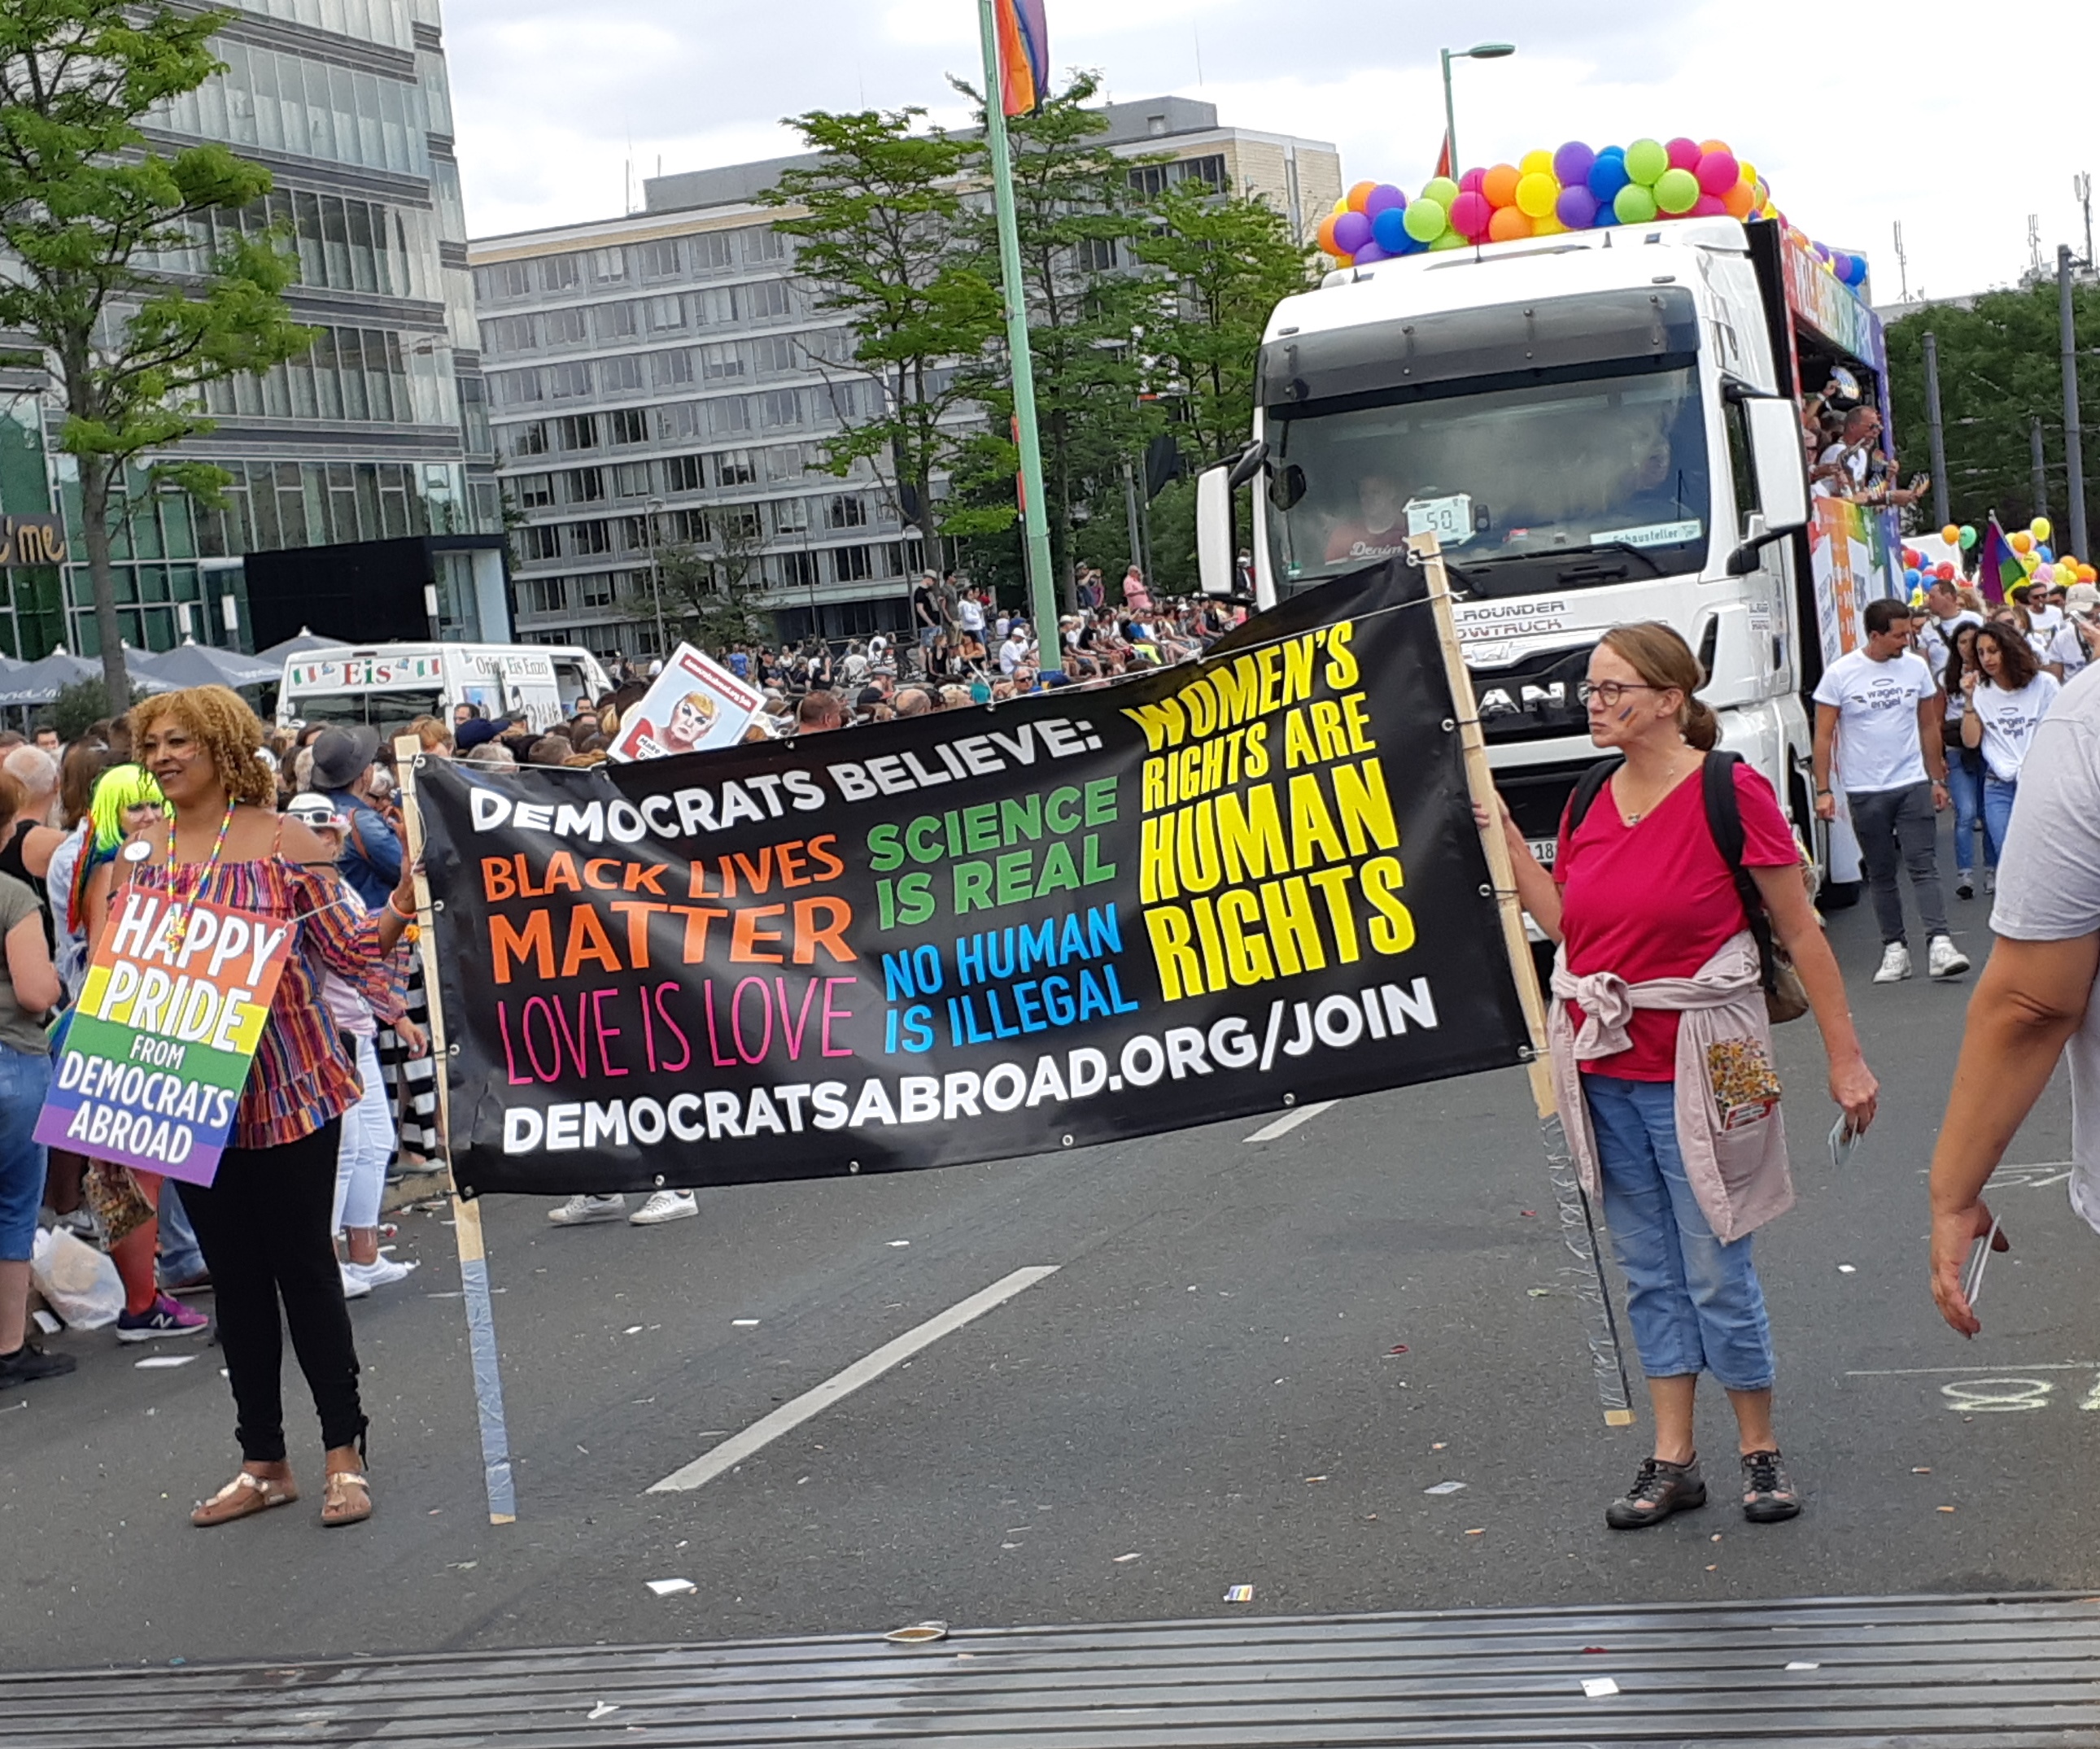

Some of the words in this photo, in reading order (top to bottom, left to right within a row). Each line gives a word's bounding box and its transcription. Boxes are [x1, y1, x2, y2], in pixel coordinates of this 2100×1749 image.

[1426, 510, 1452, 531] 50
[343, 659, 392, 686] Eis
[1120, 620, 1360, 753] WOMEN'S
[1867, 687, 1903, 699] wagen
[1871, 696, 1901, 709] engel
[470, 770, 825, 843] DEMOCRATS
[827, 717, 1103, 801] BELIEVE:
[1142, 727, 1268, 814] RIGHTS
[1285, 692, 1376, 770] ARE
[481, 851, 669, 901] BLACK
[688, 834, 844, 898] LIVES
[867, 776, 1118, 872] SCIENCE
[1139, 757, 1400, 905] HUMAN
[876, 874, 936, 930] IS
[953, 835, 1118, 914] REAL
[111, 894, 286, 987] HAPPY
[488, 896, 857, 984] MATTER
[882, 944, 942, 1002] NO
[955, 902, 1123, 987] HUMAN
[1142, 856, 1417, 1002] RIGHTS
[98, 960, 251, 1052] PRIDE
[129, 1034, 186, 1070] FROM
[498, 988, 628, 1085] LOVE
[640, 981, 691, 1072] IS
[704, 976, 857, 1066] LOVE
[884, 1007, 934, 1054] IS
[948, 963, 1139, 1047] ILLEGAL
[58, 1051, 234, 1128] DEMOCRATS
[503, 977, 1439, 1154] DEMOCRATSABROAD.ORG/JOIN
[67, 1101, 193, 1165] ABROAD
